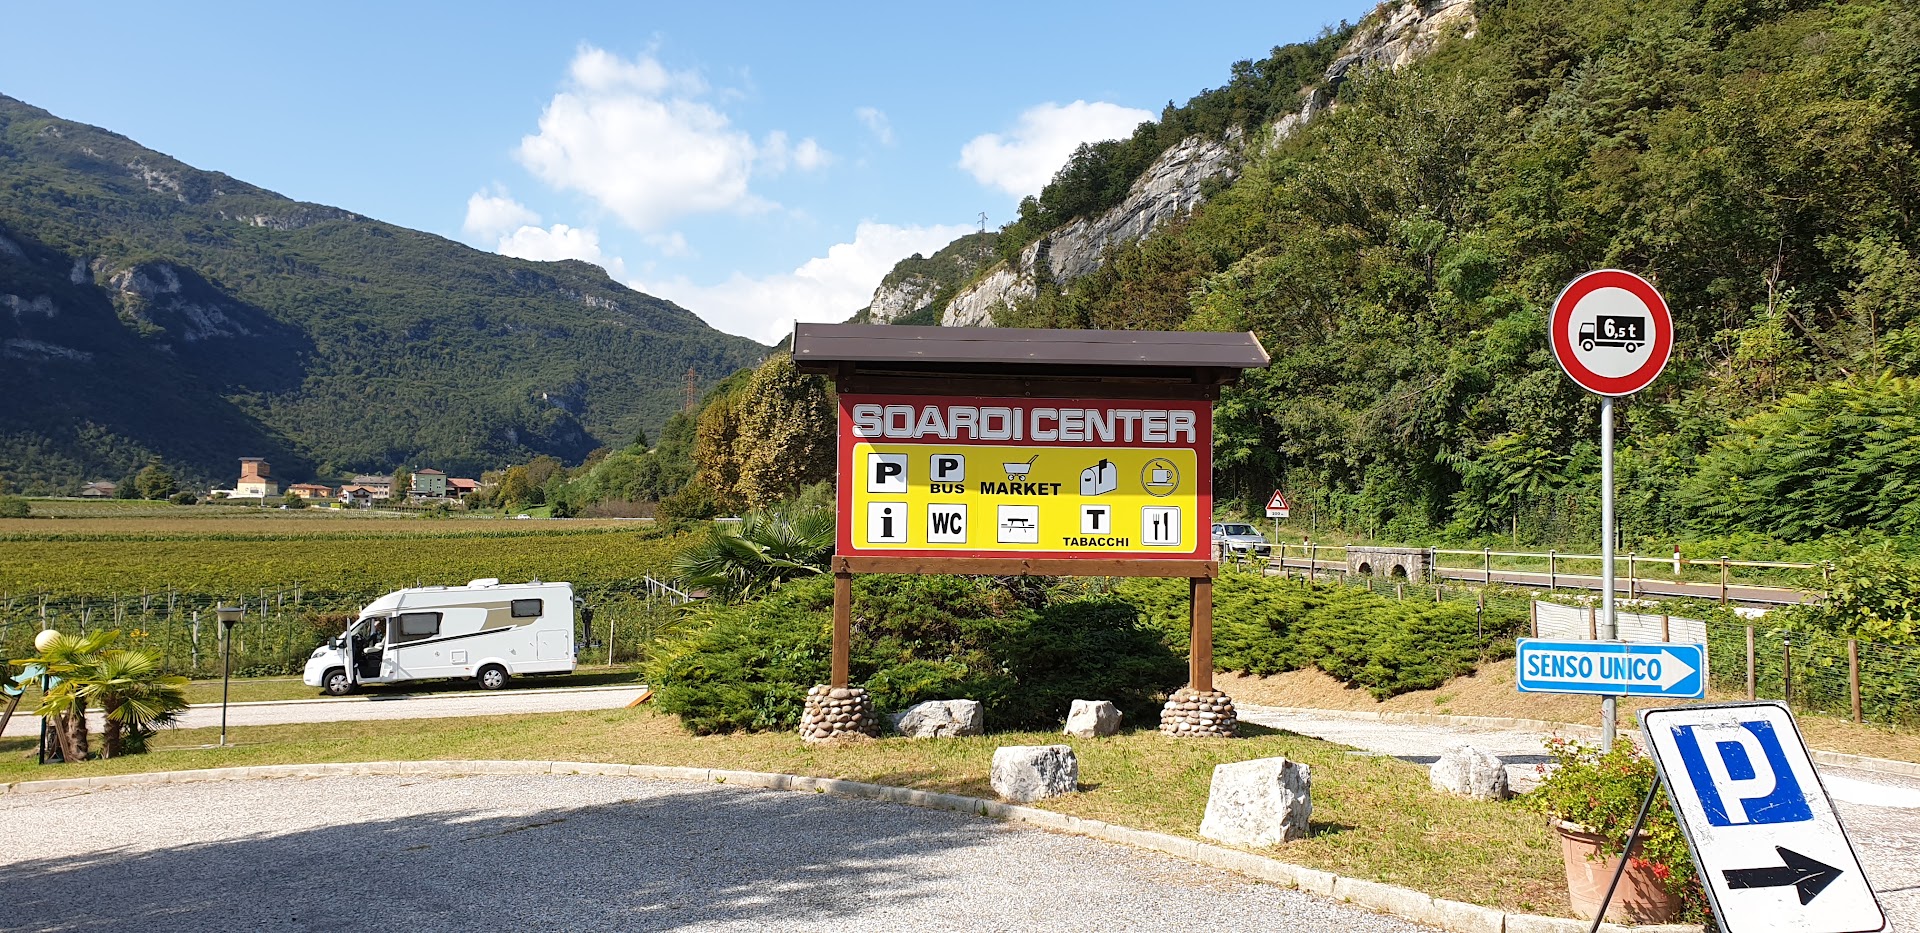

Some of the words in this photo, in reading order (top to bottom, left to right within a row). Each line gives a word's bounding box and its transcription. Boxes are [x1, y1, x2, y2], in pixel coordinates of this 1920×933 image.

[1604, 318, 1626, 339] 6,5
[1628, 323, 1637, 337] t
[852, 404, 1023, 440] SOARDI
[1030, 408, 1196, 443] CENTER
[876, 462, 902, 484] P
[938, 458, 959, 478] P
[930, 483, 965, 494] BUS
[980, 482, 1062, 496] MARKET
[881, 507, 894, 538] i
[932, 512, 962, 534] WC
[1086, 509, 1105, 530] T
[1062, 537, 1129, 547] TABACCHI
[1527, 654, 1592, 678] SENSO
[1600, 656, 1661, 681] UNICO
[1691, 724, 1776, 824] P
